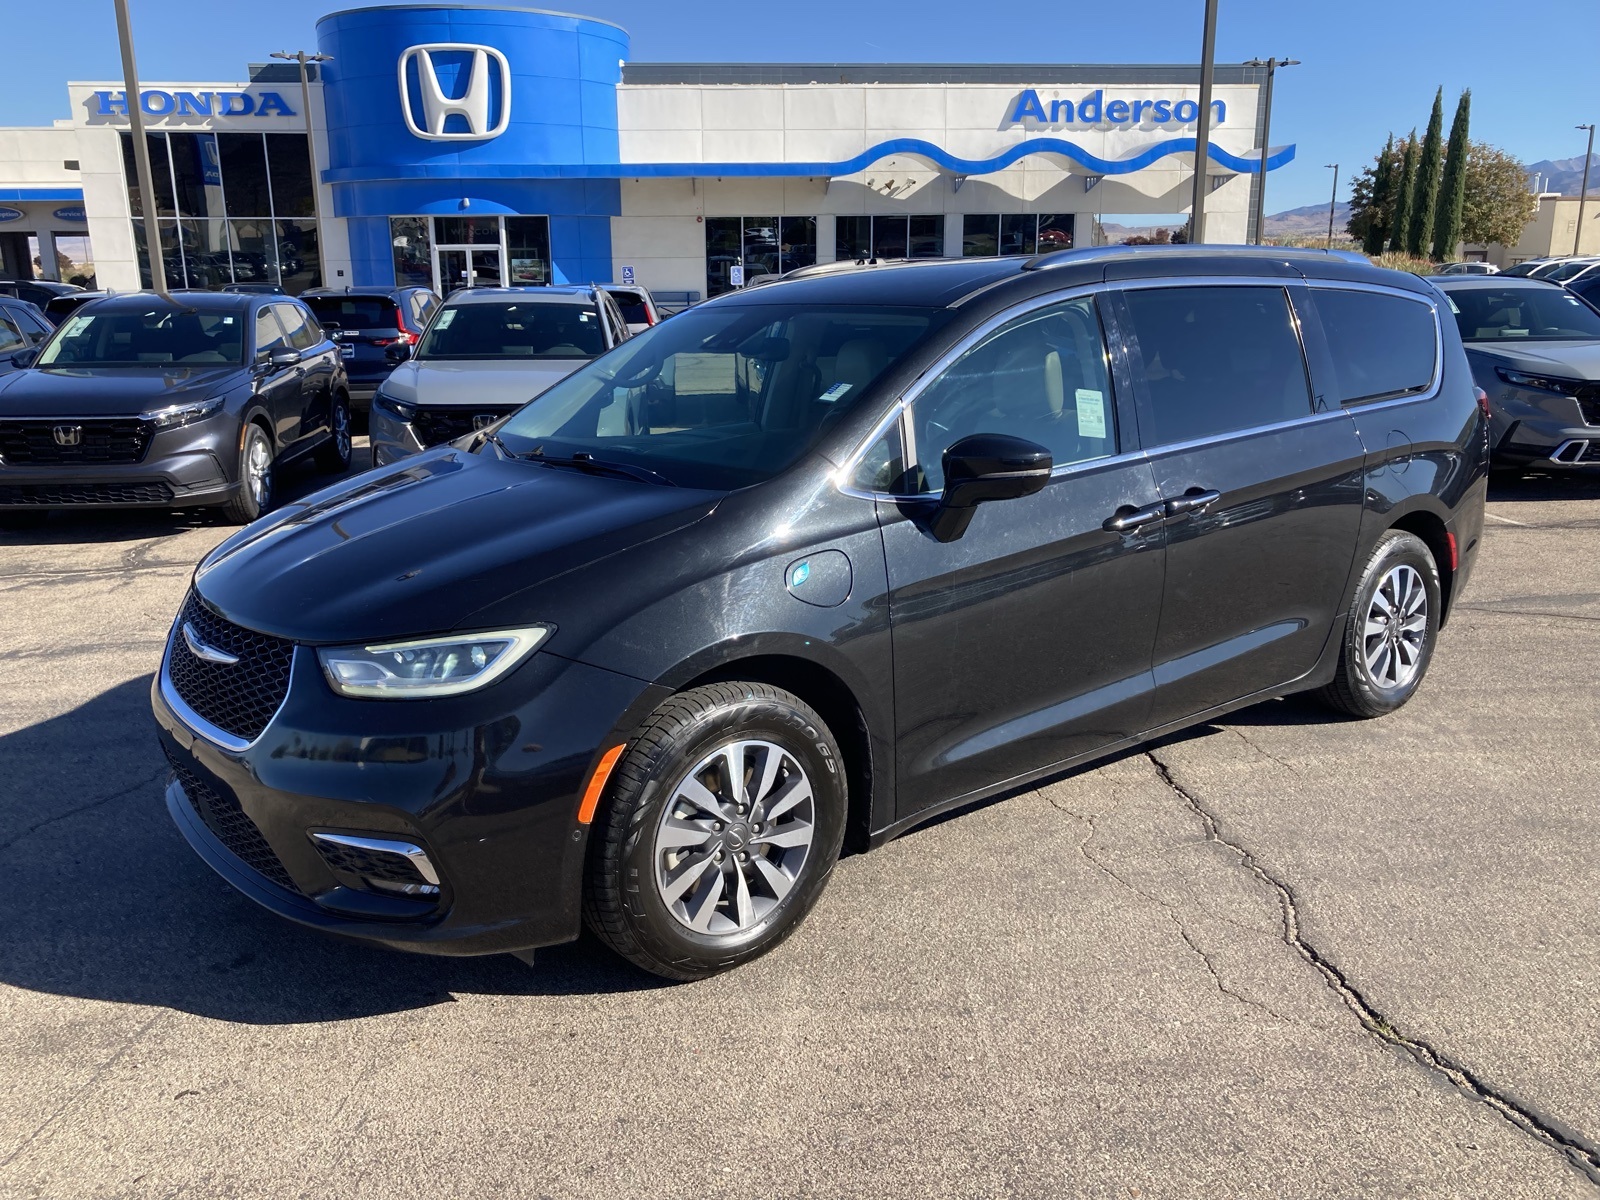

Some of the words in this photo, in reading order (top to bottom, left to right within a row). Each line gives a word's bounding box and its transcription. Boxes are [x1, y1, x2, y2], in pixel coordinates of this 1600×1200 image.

[93, 90, 298, 117] HONDA
[1011, 88, 1227, 124] Anderson
[450, 228, 499, 236] WECOM
